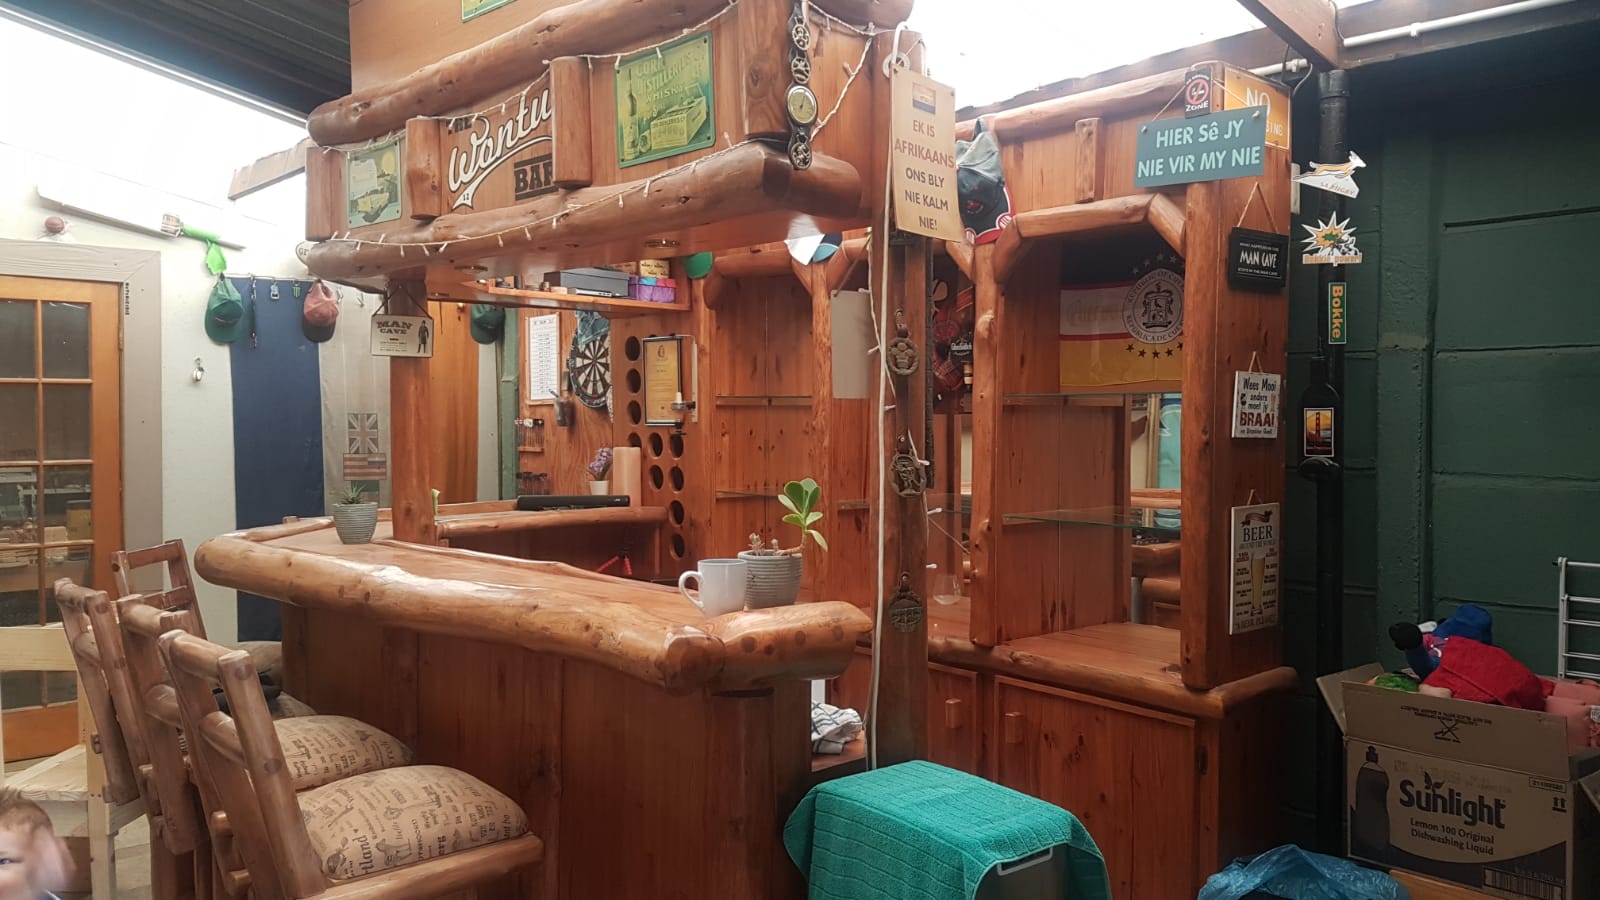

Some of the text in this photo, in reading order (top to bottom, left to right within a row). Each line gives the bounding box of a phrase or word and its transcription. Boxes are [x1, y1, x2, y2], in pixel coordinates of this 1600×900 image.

[1185, 101, 1209, 112] ZONE
[912, 119, 936, 138] EK IS
[1156, 126, 1194, 149] HIER
[1223, 119, 1244, 140] JY
[894, 138, 955, 169] AFRIKAANS
[1137, 146, 1261, 178] NIE VIR MY NIE
[905, 166, 945, 189] ONS BLY
[904, 189, 949, 212] NIE KALM
[918, 214, 938, 231] NIE!
[1240, 250, 1278, 268] MAN CAVE
[1332, 286, 1344, 338] Bokke
[376, 320, 413, 330] MAN
[1243, 377, 1276, 392] Wees Mooi
[1240, 412, 1274, 428] BRAAI
[1243, 525, 1273, 542] BEER
[1400, 778, 1506, 829] Sunlight
[1410, 817, 1495, 844] Lemon 100 Original
[1411, 828, 1494, 855] Dishwashing Liquid
